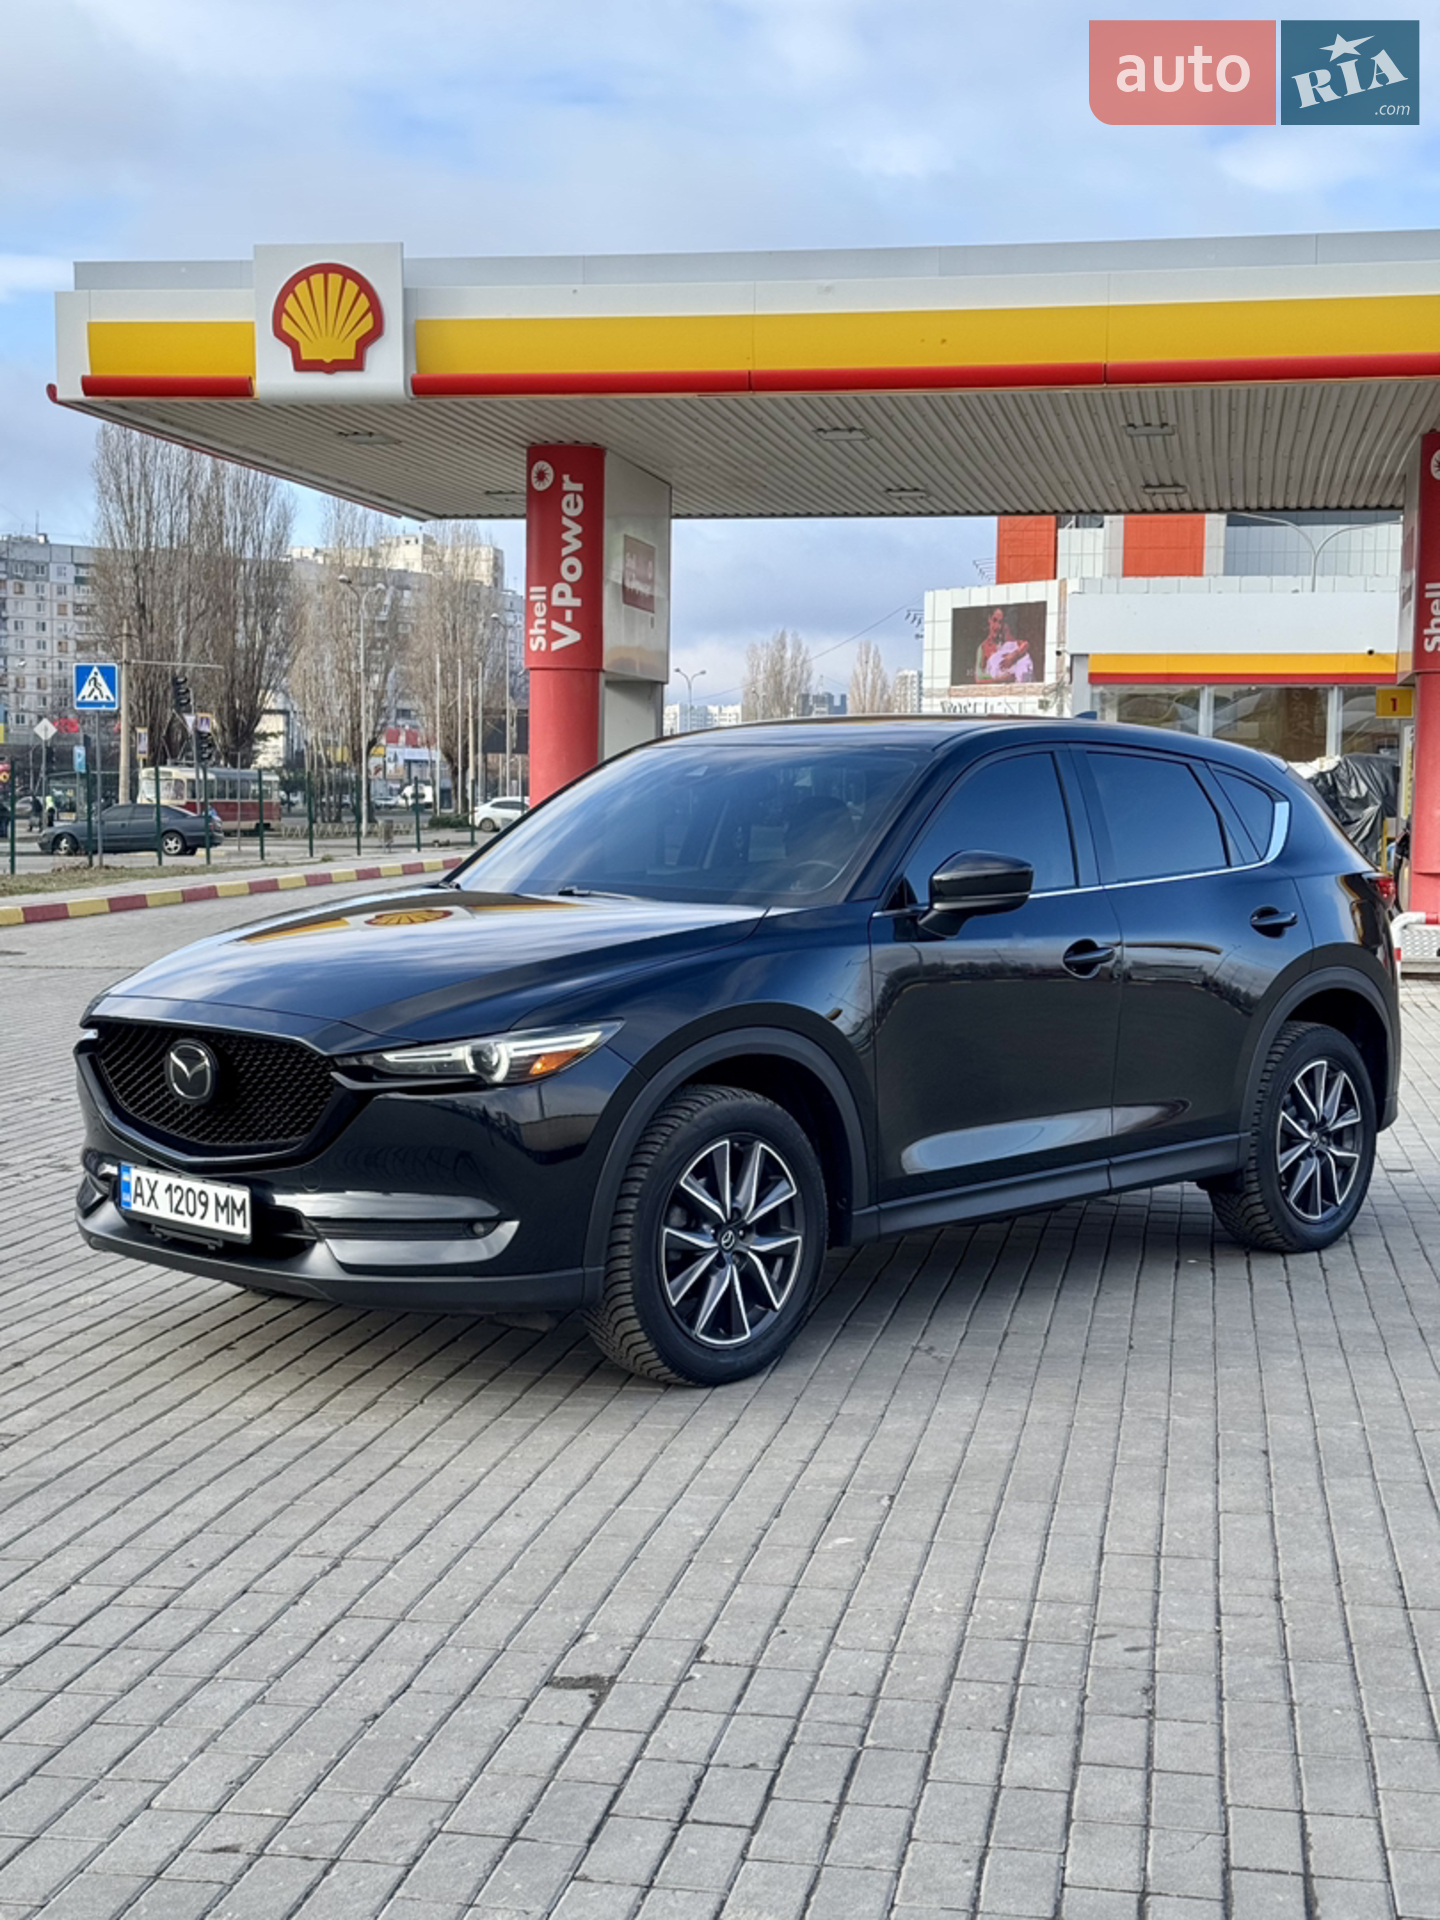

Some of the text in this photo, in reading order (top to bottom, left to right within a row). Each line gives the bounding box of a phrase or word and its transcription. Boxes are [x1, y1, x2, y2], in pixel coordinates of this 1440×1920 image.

[551, 474, 584, 651] V-Power
[529, 586, 547, 651] Shell
[1424, 583, 1440, 652] Shell
[1390, 697, 1397, 712] 1
[133, 1176, 246, 1228] AX 1209 MM
